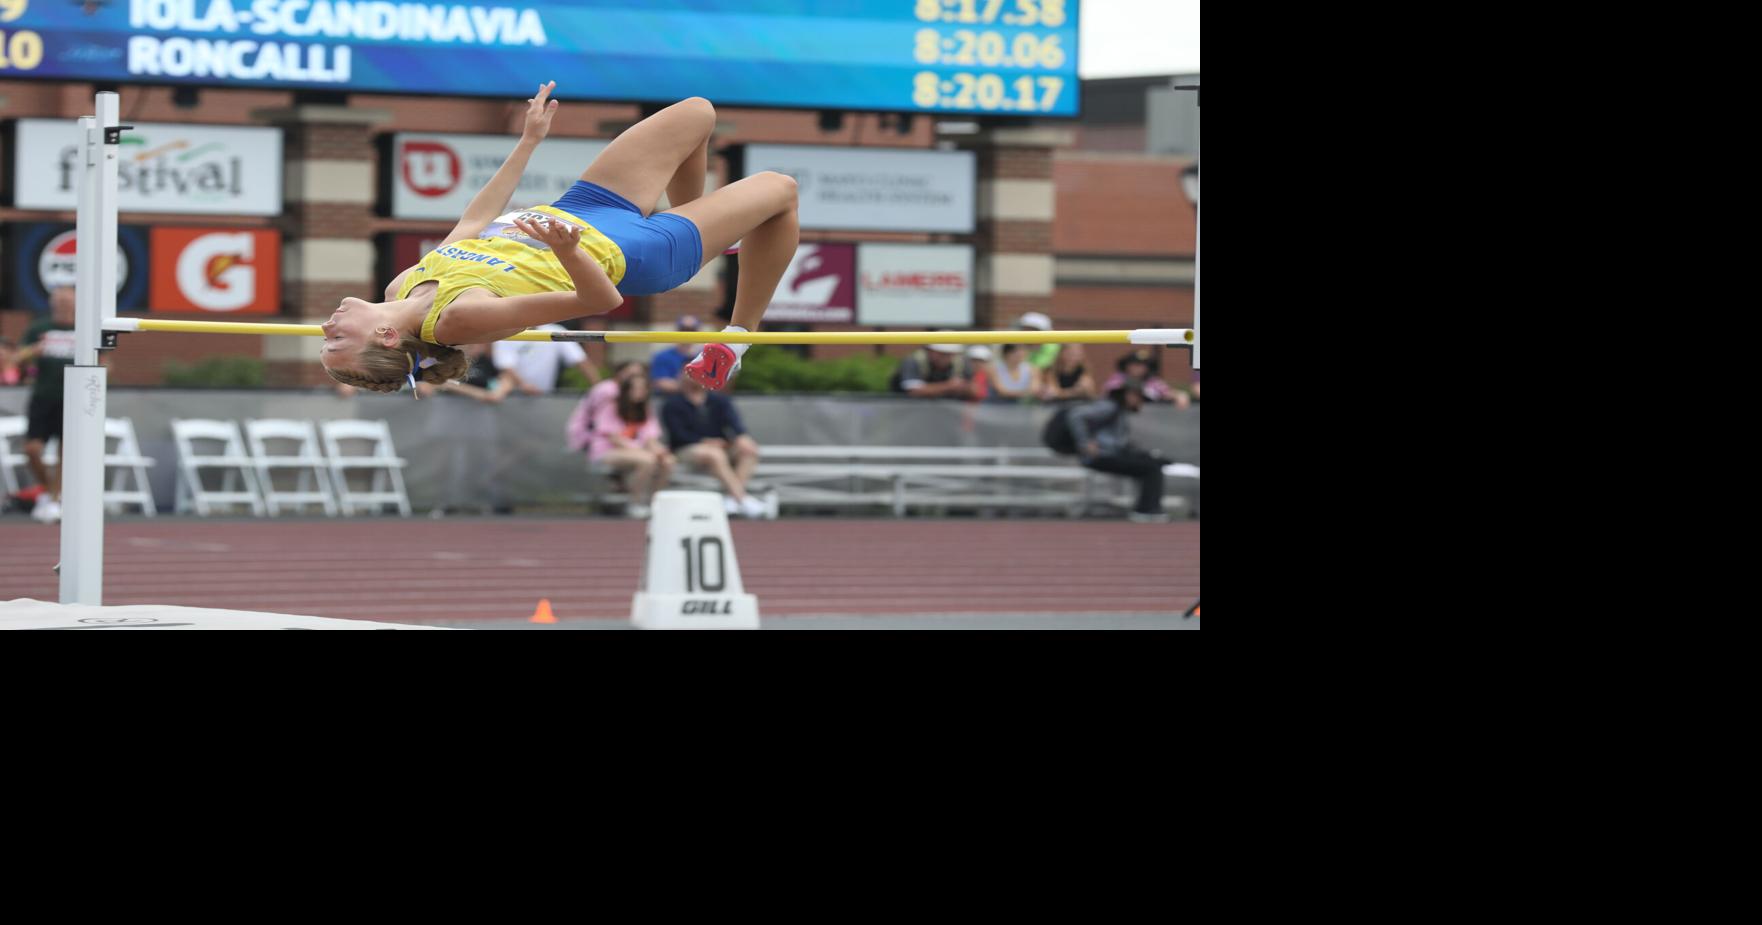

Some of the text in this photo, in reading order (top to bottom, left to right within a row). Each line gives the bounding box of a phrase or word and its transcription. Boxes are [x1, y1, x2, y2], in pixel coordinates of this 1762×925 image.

[129, 0, 548, 46] IOLA-SCANDINAVIA
[914, 28, 1066, 70] 8:20.06
[914, 0, 1066, 27] 8:17.58
[127, 35, 351, 82] RONCALLI
[912, 70, 1065, 112] 8:20.17
[58, 144, 243, 197] fstival
[680, 534, 726, 593] 10
[680, 599, 733, 615] GILL
